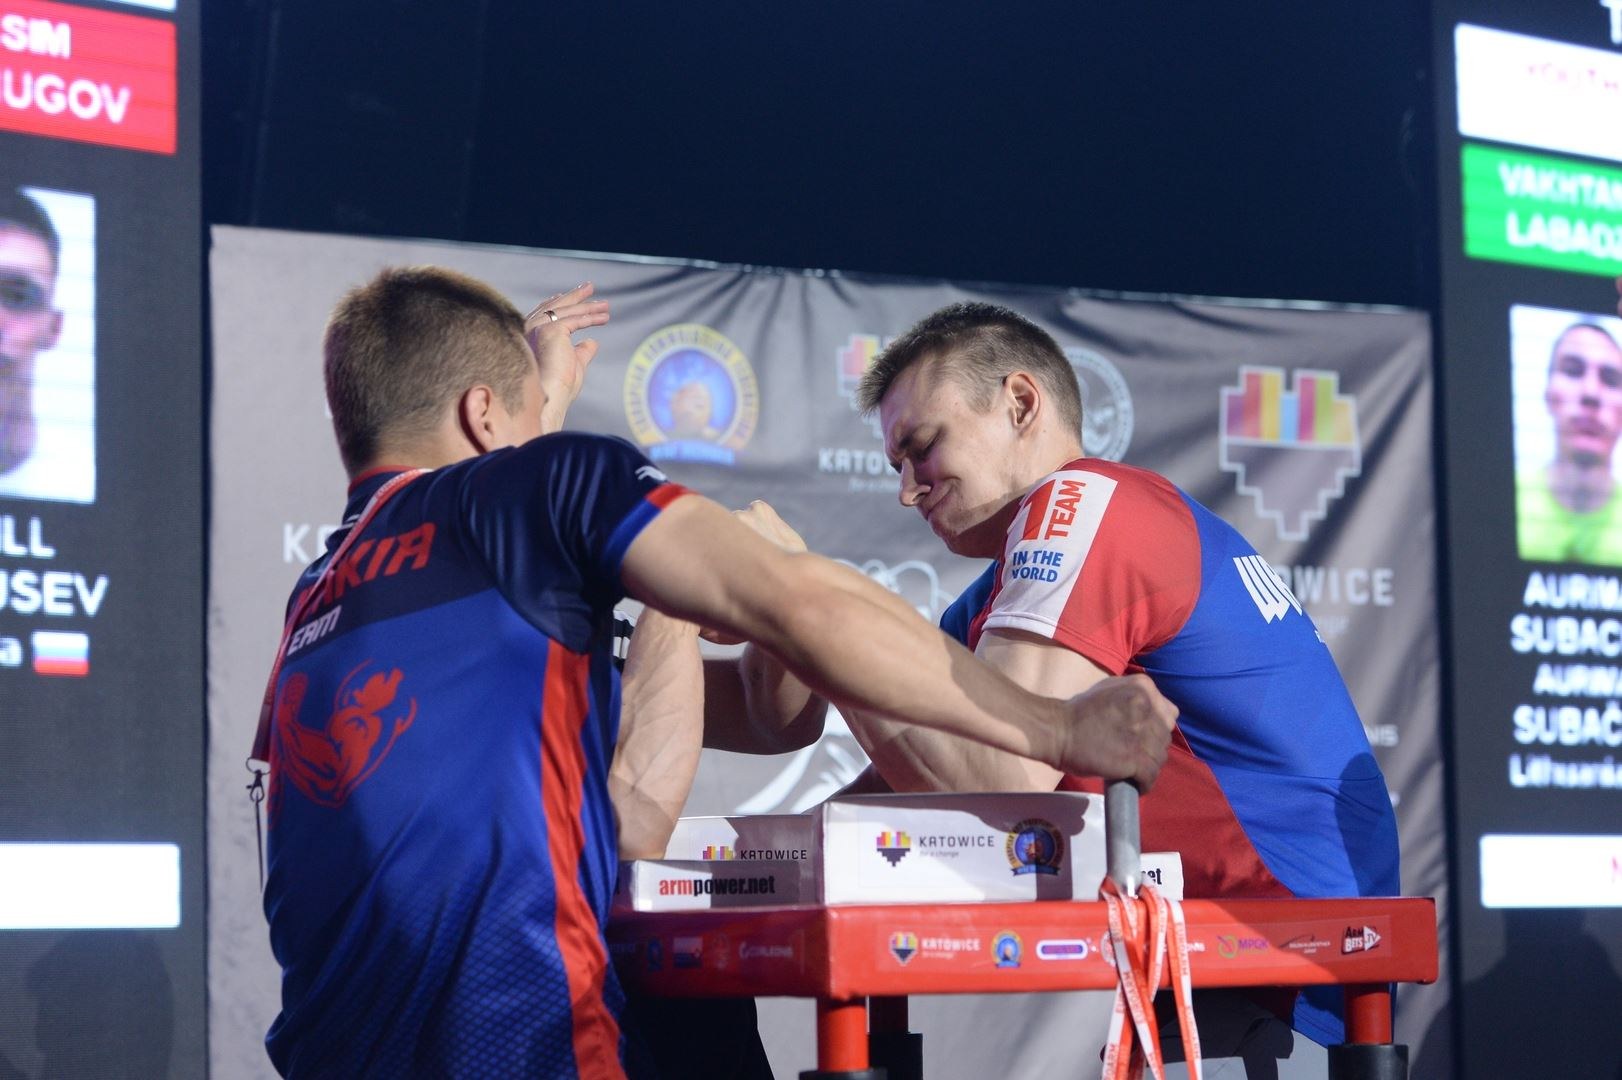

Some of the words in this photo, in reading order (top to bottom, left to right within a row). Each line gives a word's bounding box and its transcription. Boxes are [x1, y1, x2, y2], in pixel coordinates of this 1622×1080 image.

[2, 69, 131, 124] UGOV
[1044, 480, 1087, 541] TEAM
[1012, 550, 1030, 567] IN
[1032, 549, 1065, 568] THE
[1523, 571, 1622, 612] AURIM
[286, 605, 343, 658] EAM
[740, 849, 808, 861] KATOWICE
[919, 835, 995, 849] KATOWICE
[659, 874, 776, 897] armpower.net
